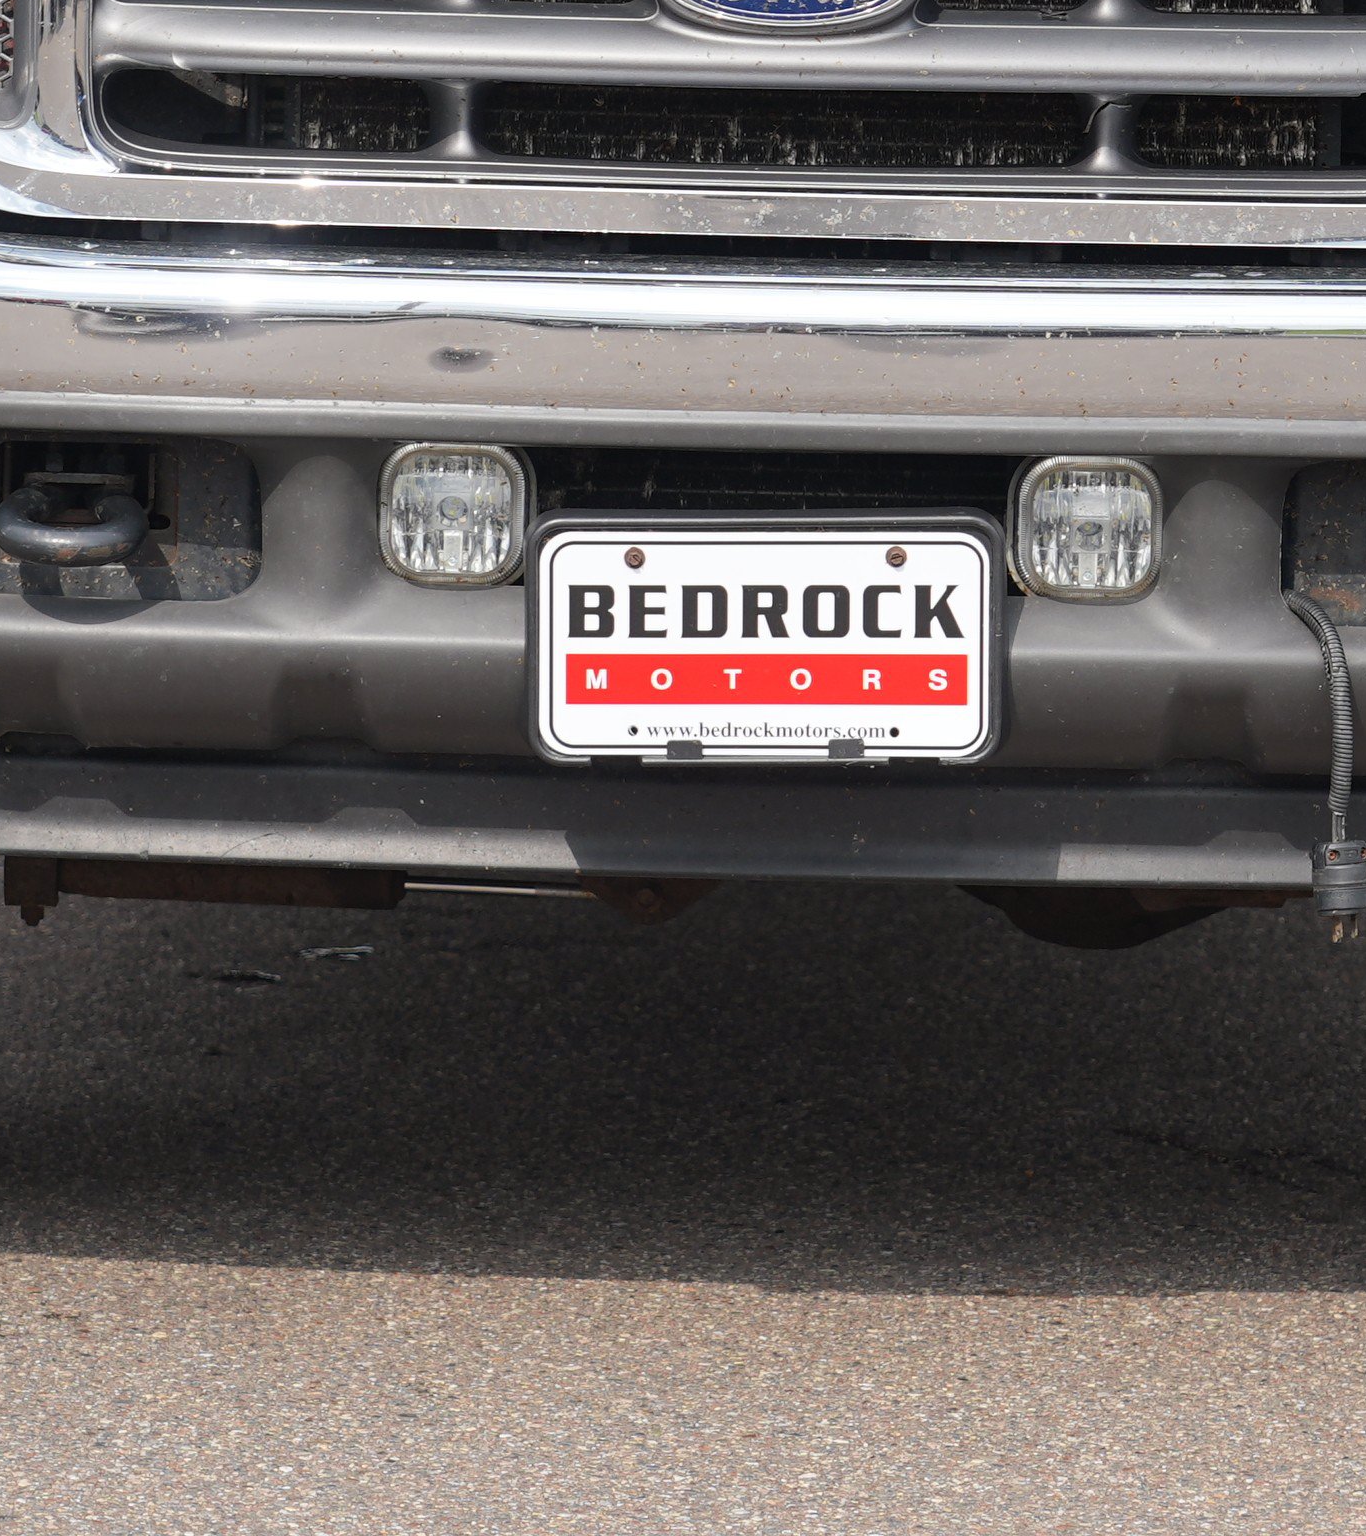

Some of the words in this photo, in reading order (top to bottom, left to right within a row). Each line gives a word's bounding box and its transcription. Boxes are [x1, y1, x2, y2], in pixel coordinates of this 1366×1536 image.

[568, 584, 964, 638] BEDROCK
[586, 669, 948, 690] MOTORS
[647, 722, 885, 739] www.bedrockmotors.com
